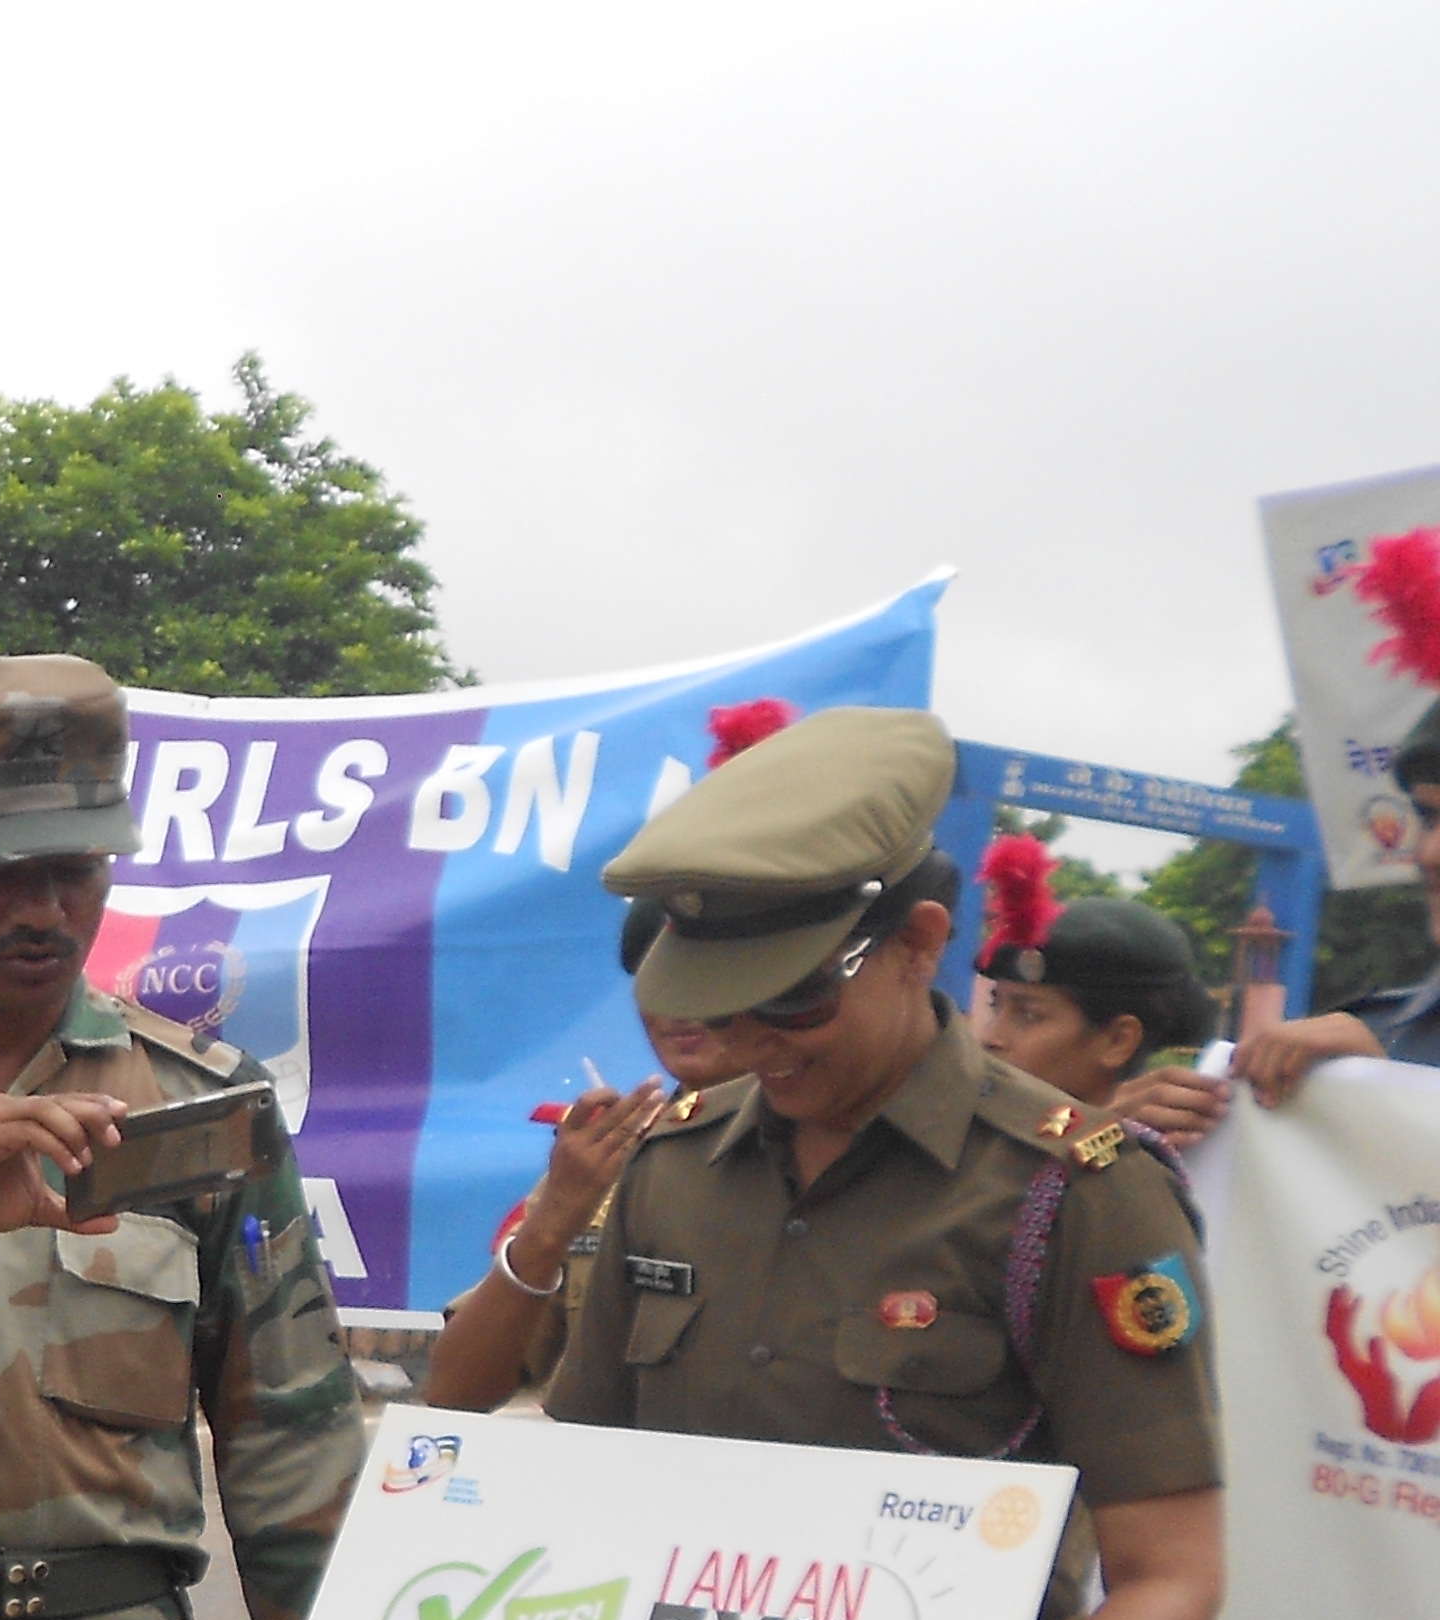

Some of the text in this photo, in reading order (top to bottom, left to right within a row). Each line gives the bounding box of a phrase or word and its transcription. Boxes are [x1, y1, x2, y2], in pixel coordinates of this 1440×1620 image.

[110, 738, 389, 864] RLS
[407, 730, 601, 873] BN
[140, 962, 218, 995] NCC
[1316, 1219, 1389, 1278] Shine
[879, 1492, 975, 1531] Rotary
[1313, 1463, 1440, 1524] 80-G Re
[659, 1546, 681, 1603] I
[682, 1549, 780, 1615] AM
